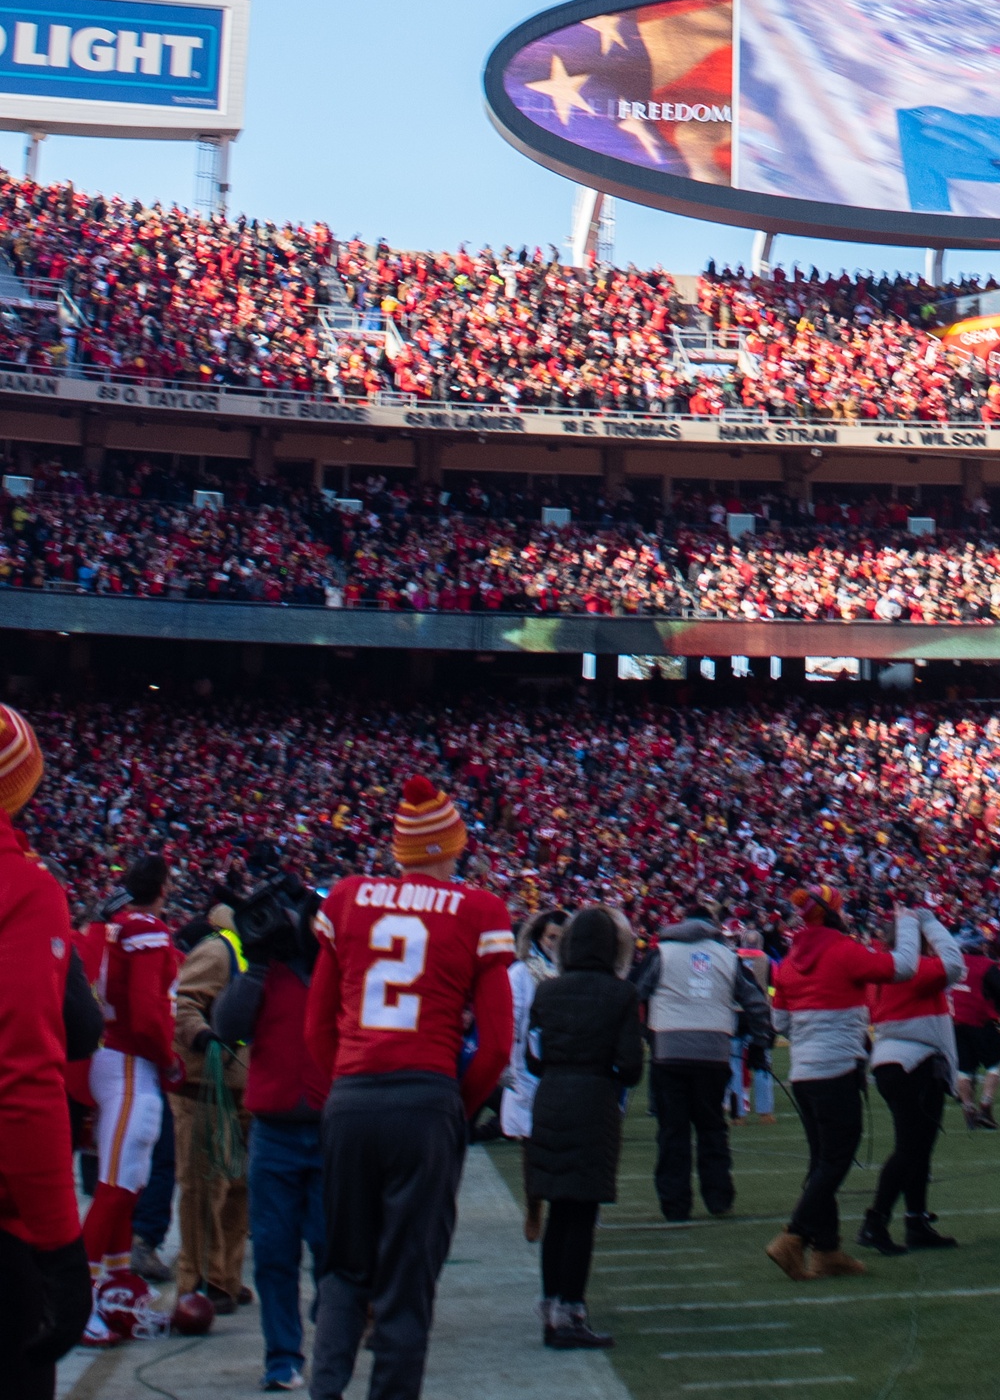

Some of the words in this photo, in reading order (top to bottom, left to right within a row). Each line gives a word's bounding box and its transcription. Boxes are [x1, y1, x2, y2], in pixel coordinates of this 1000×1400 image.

[12, 21, 203, 78] LIGHT
[617, 100, 732, 123] FREEDOM
[146, 390, 219, 411] TAYLOR
[602, 421, 682, 440] THOMAS
[719, 426, 770, 441] HANK
[775, 427, 838, 443] STRAM
[919, 432, 987, 446] WILSON
[355, 881, 465, 916] COLQUITT
[359, 913, 430, 1032] 2
